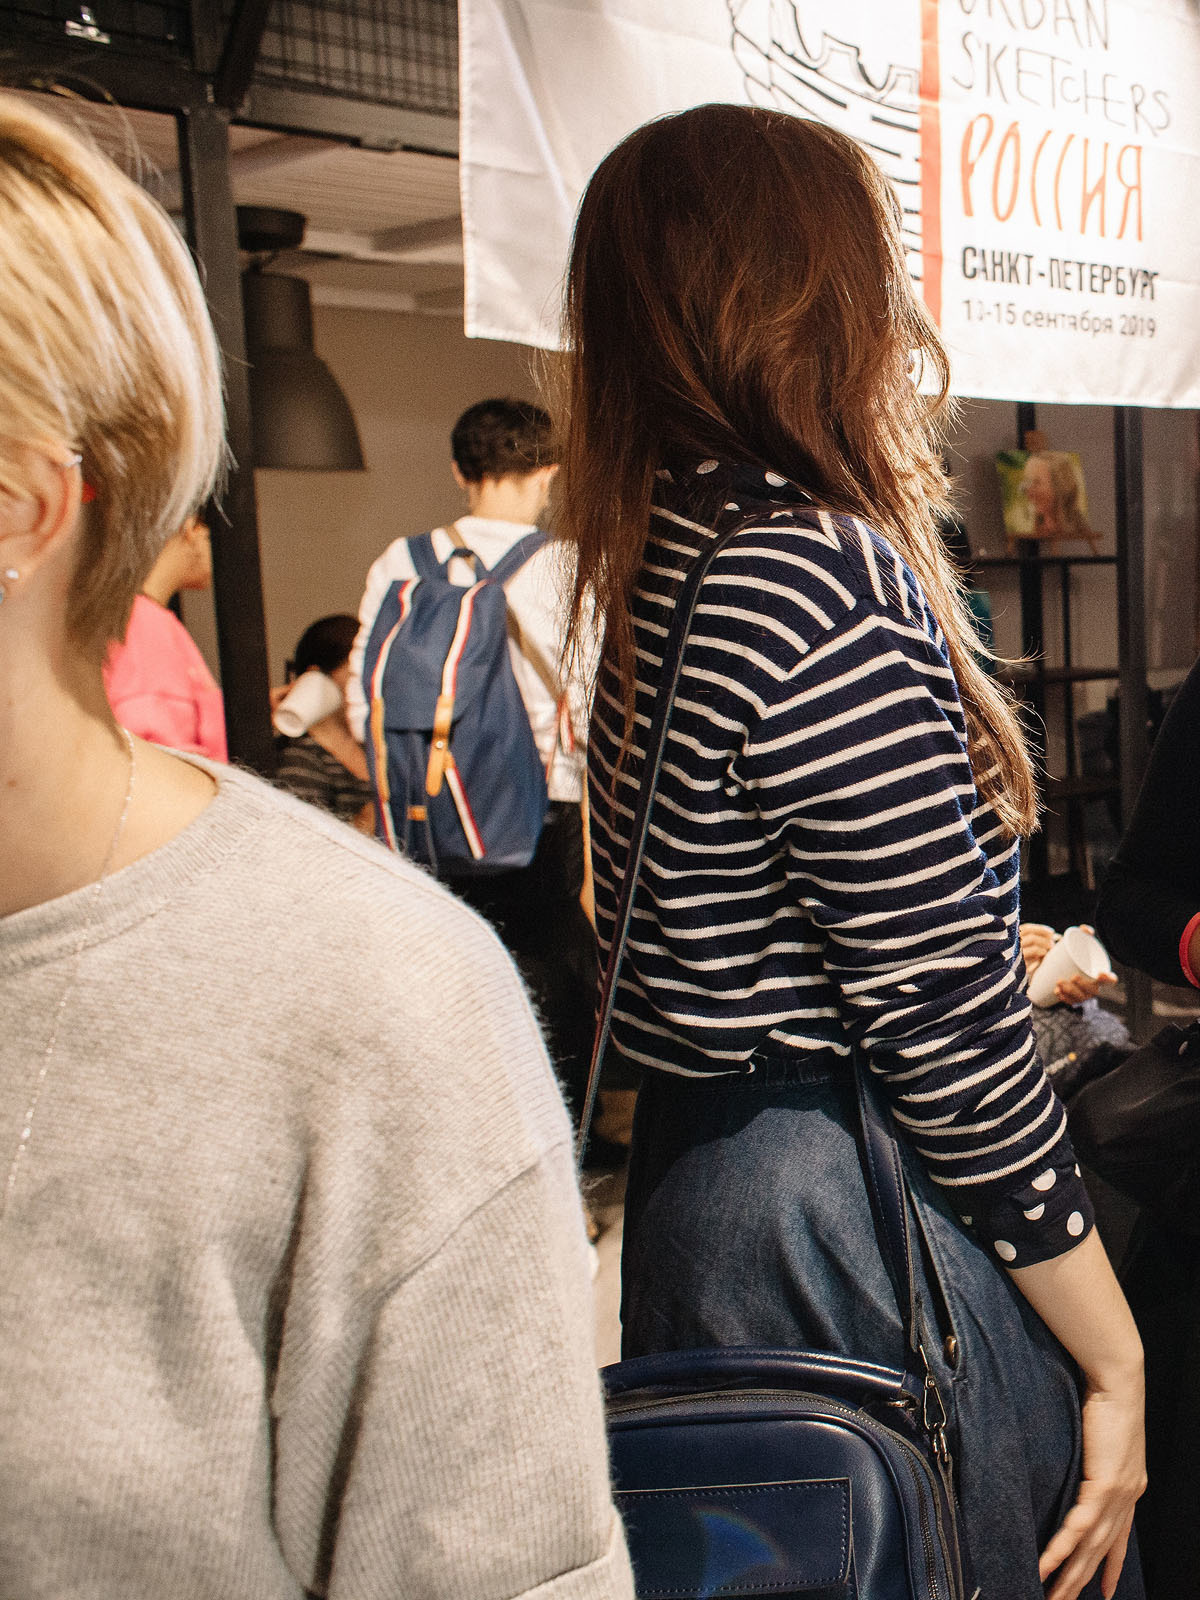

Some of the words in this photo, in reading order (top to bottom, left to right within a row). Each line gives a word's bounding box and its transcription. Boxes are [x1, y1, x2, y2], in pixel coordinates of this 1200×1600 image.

[952, 31, 1172, 137] SKETCHERS
[960, 113, 1144, 242] РОССИЯ
[1021, 308, 1114, 338] сентября
[1119, 313, 1157, 338] 2019
